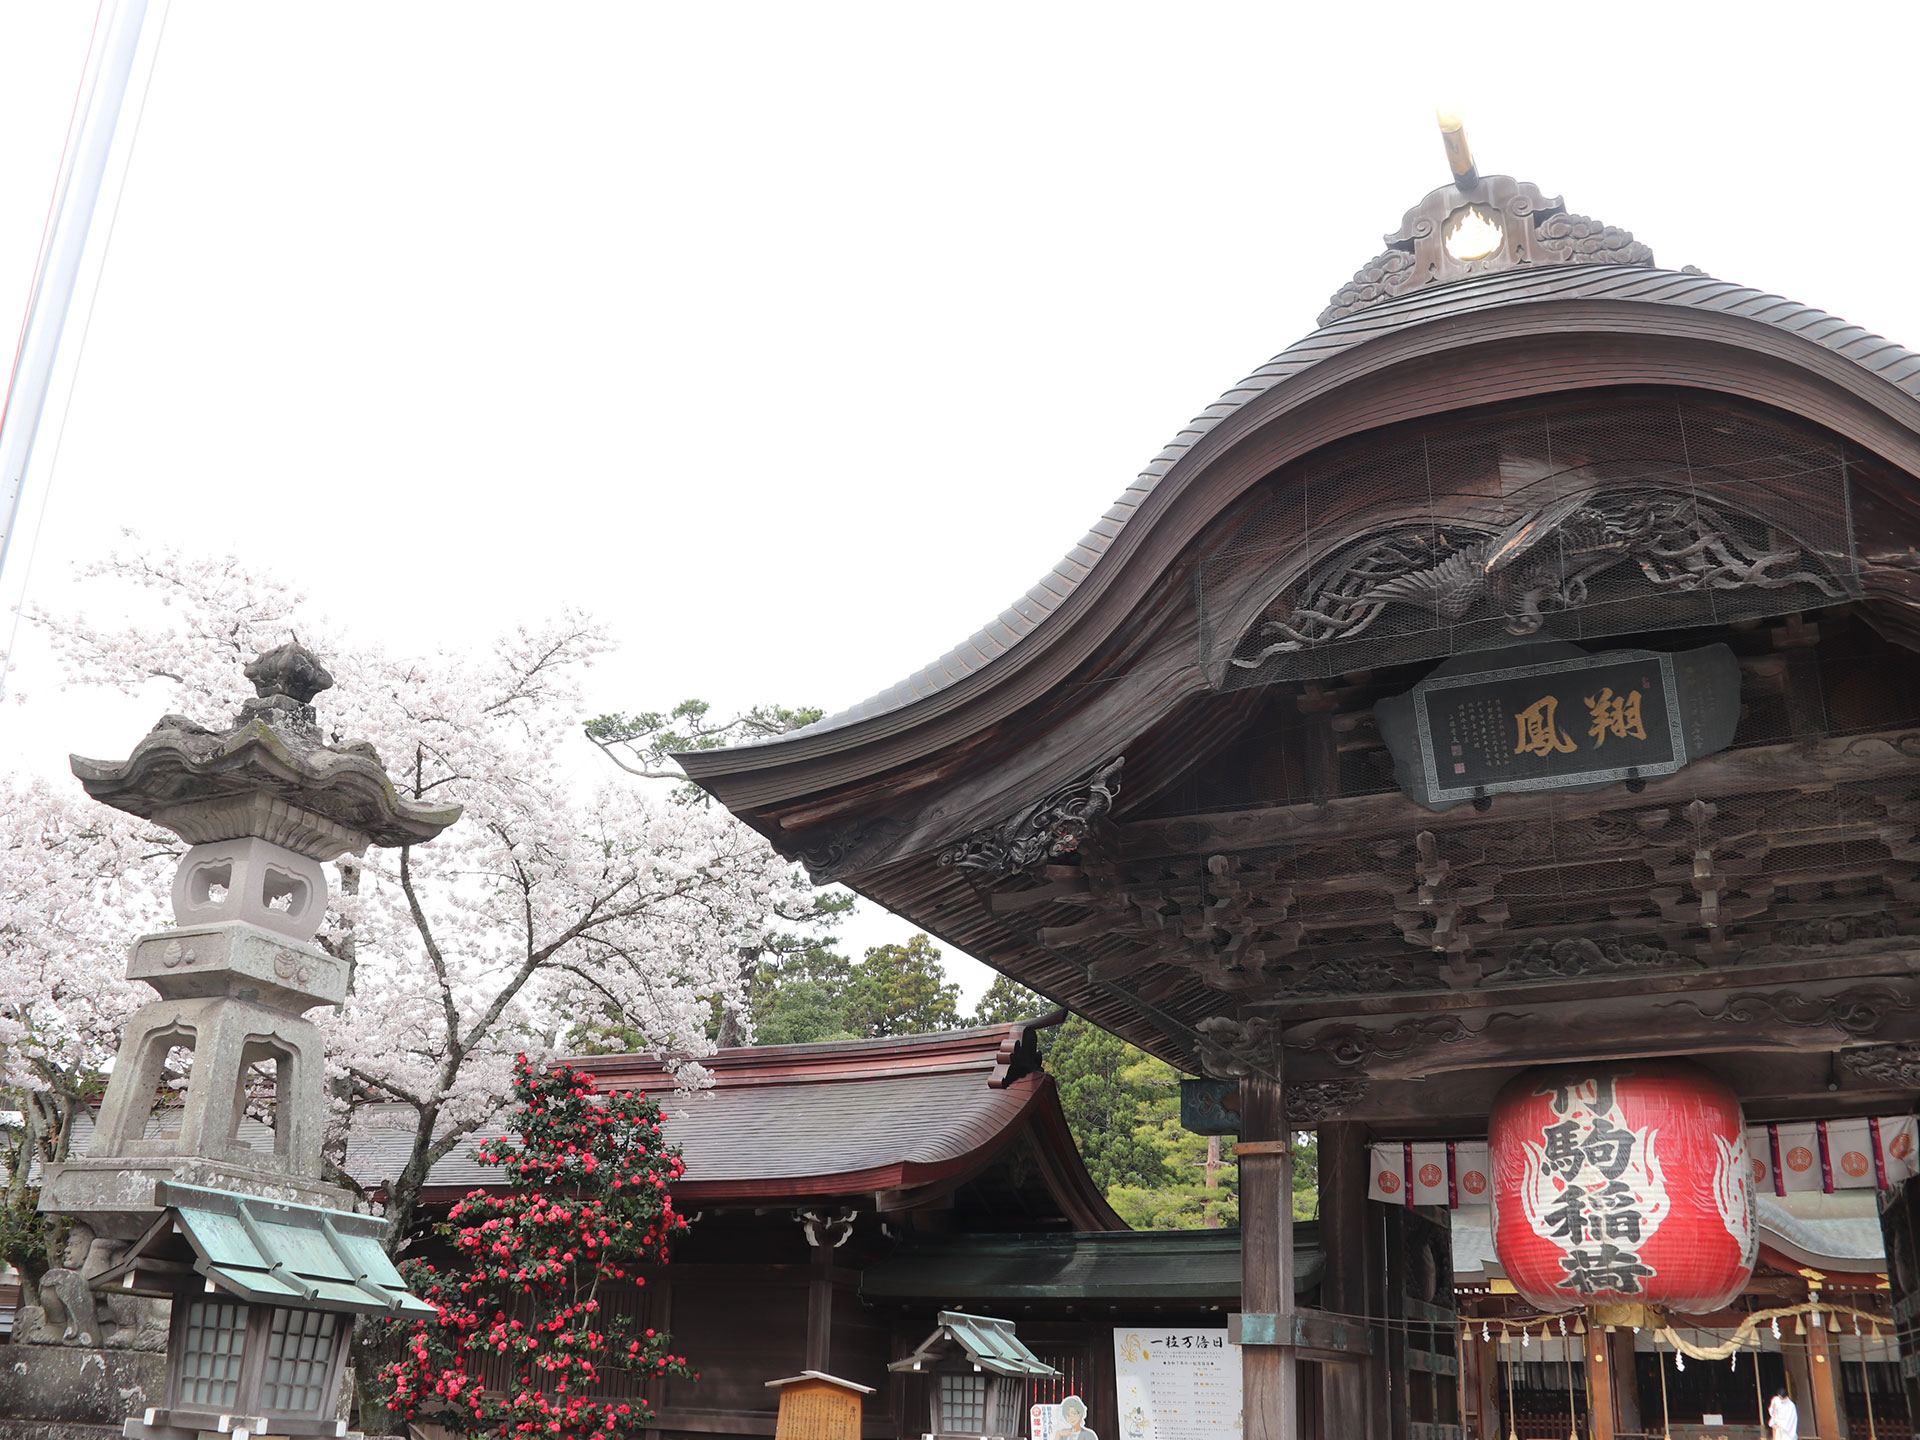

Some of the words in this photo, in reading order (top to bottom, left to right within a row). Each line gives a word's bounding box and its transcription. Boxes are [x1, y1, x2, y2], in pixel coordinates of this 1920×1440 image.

[1150, 1335, 1223, 1349] 一粒万倍日
